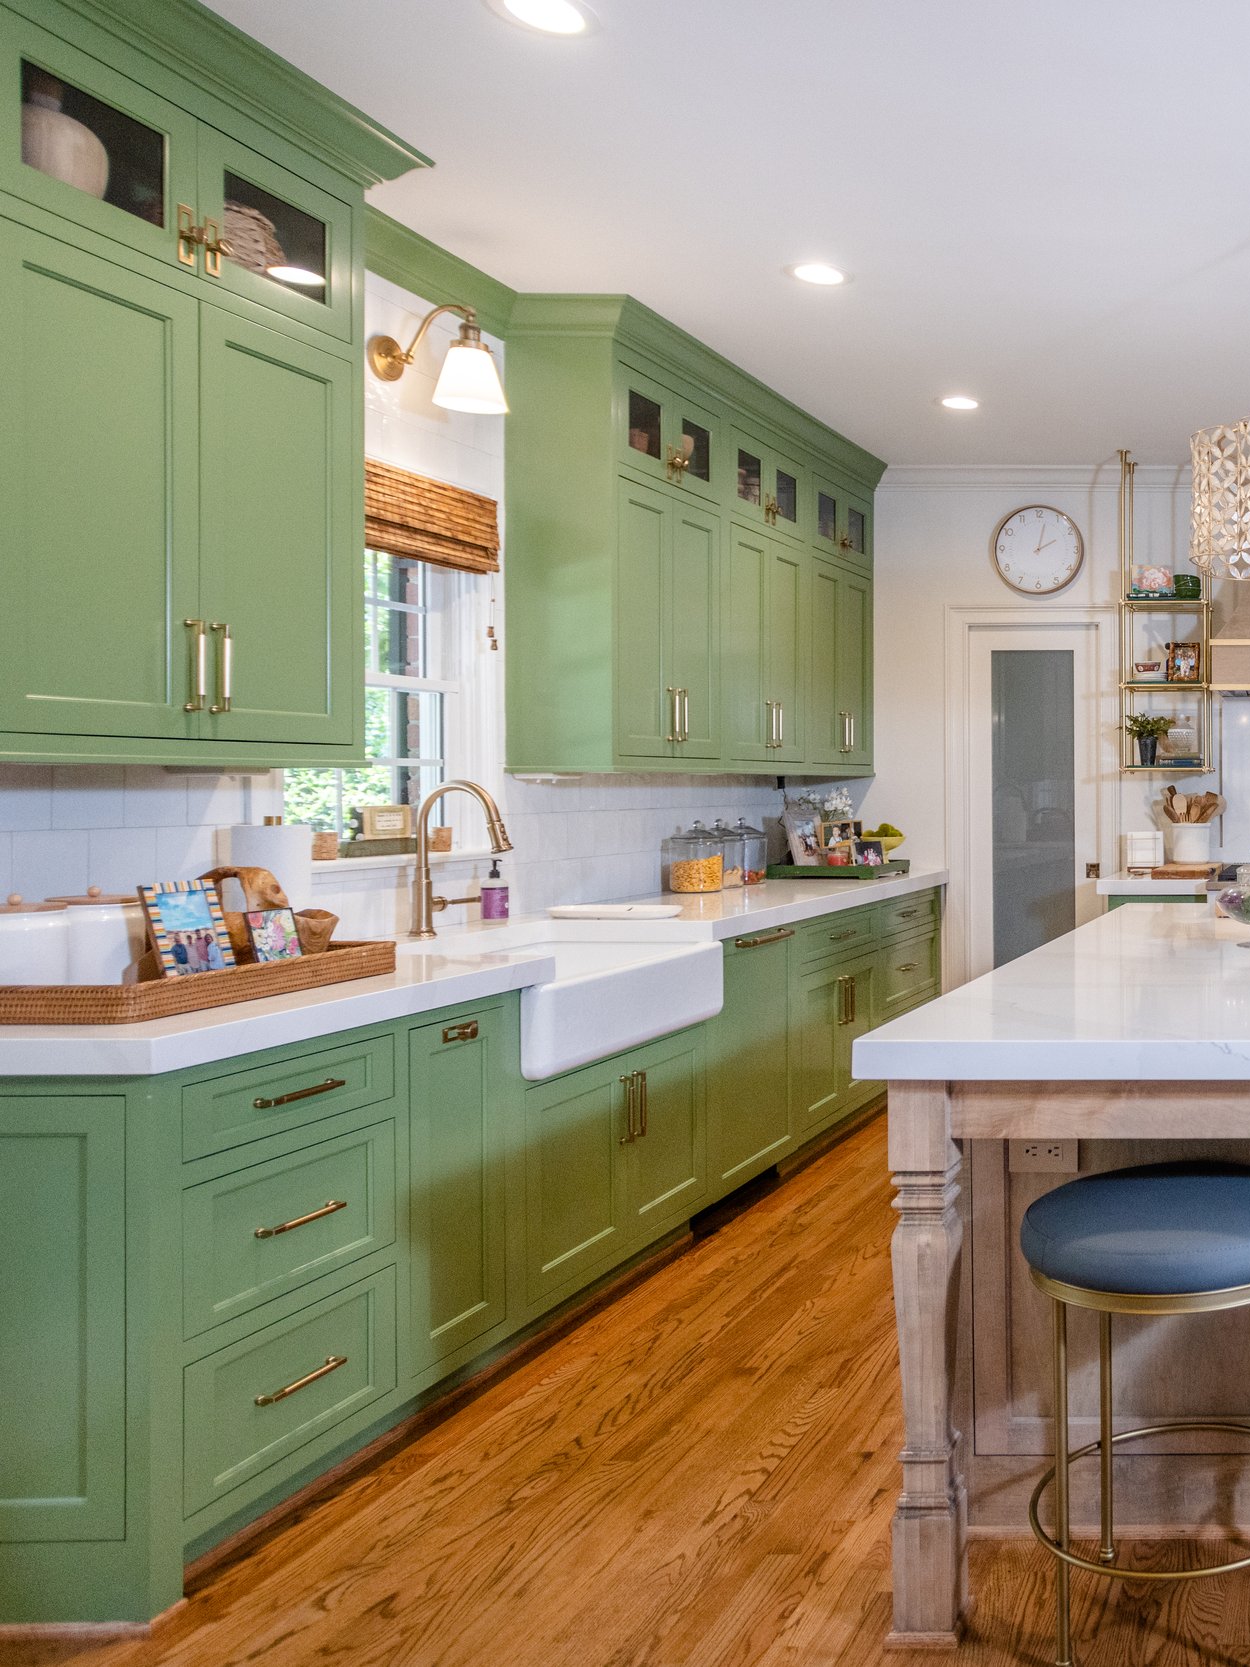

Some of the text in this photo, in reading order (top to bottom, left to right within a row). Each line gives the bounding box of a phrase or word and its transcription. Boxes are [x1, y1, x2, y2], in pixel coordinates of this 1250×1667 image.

[1035, 510, 1044, 518] 12
[1019, 515, 1025, 523] 11
[1003, 528, 1014, 536] 10
[1068, 527, 1073, 536] 2
[999, 545, 1005, 553] 9
[1073, 546, 1078, 554] 3
[1018, 576, 1023, 584] 7
[1035, 581, 1042, 589] 6
